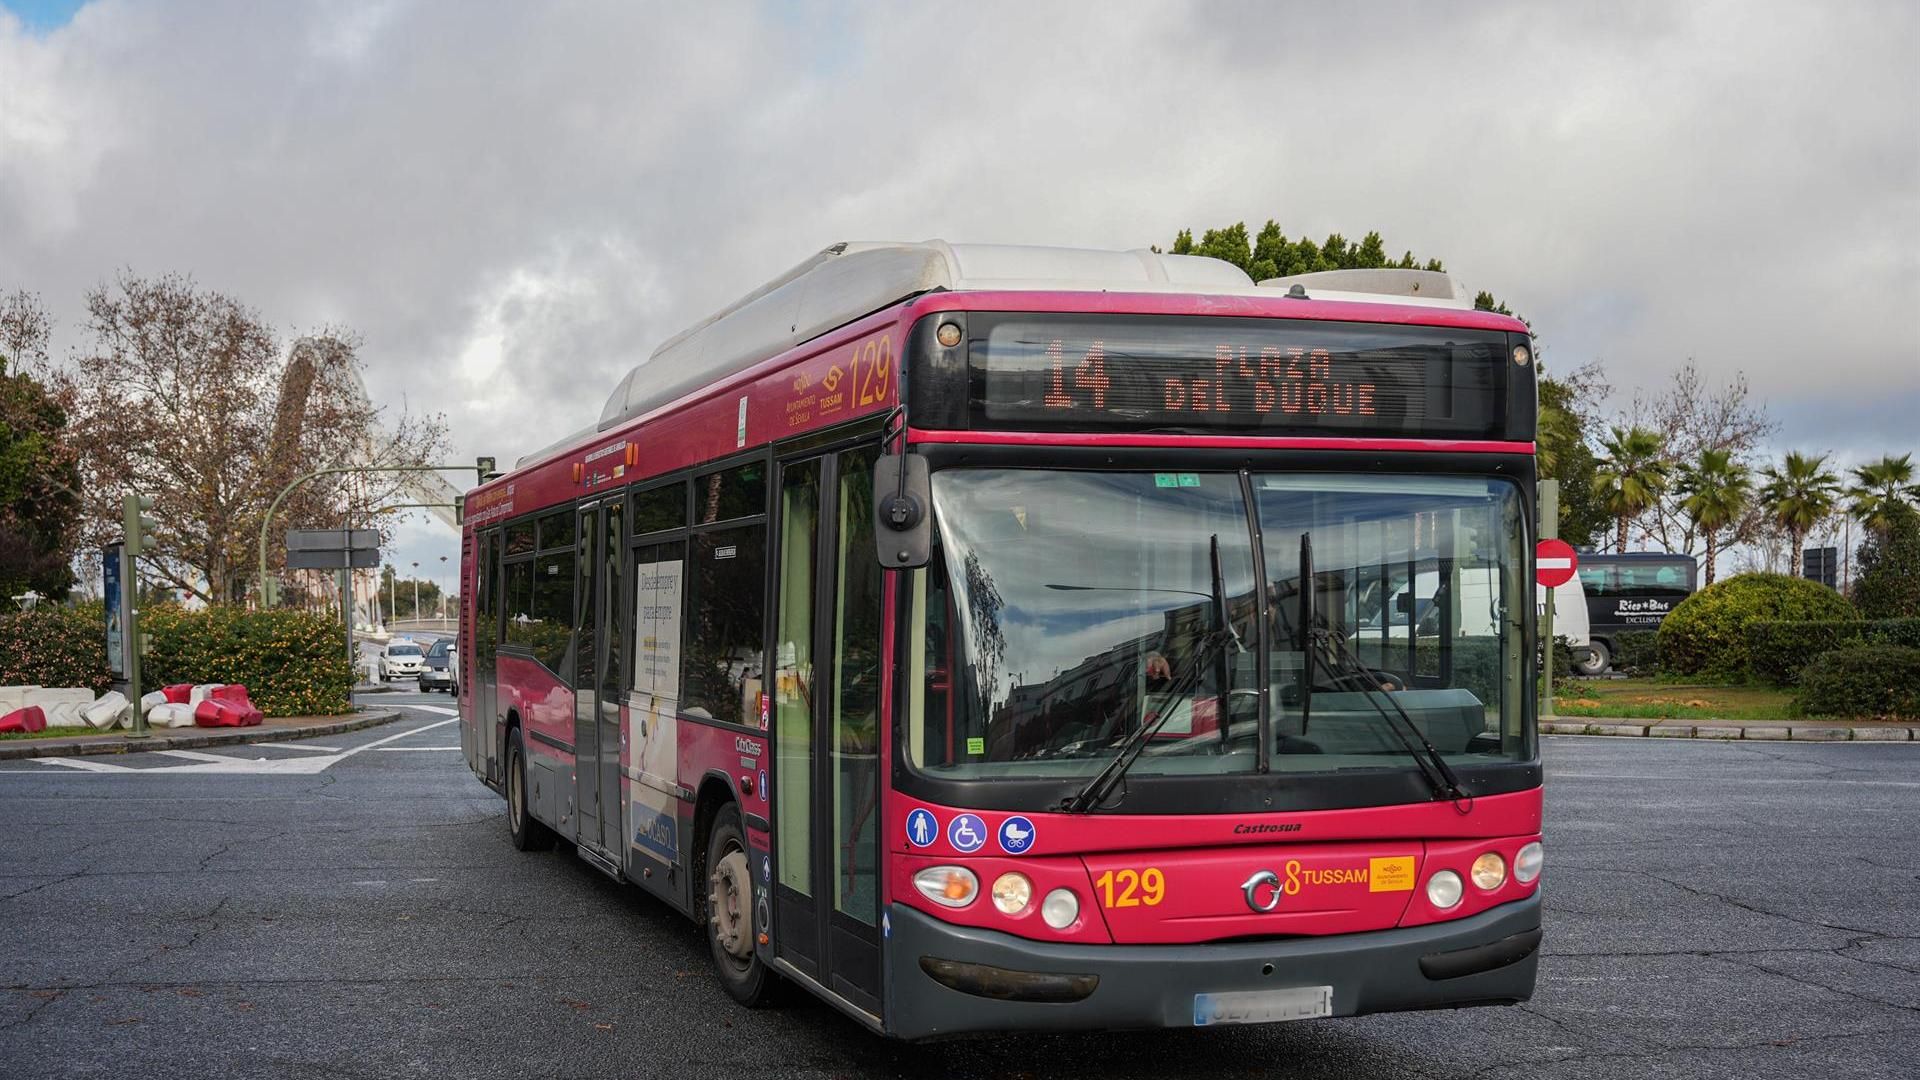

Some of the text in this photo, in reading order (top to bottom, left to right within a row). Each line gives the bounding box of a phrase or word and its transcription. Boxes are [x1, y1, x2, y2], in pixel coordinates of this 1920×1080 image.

[849, 335, 891, 409] 129
[1043, 339, 1111, 409] 14
[1215, 344, 1330, 379] PLAZA
[820, 392, 843, 409] TUSSAM
[1164, 378, 1376, 416] DEL DUQUE
[1233, 823, 1304, 834] Castrosua
[1096, 867, 1165, 908] 129
[1302, 868, 1369, 885] TUSSAM
